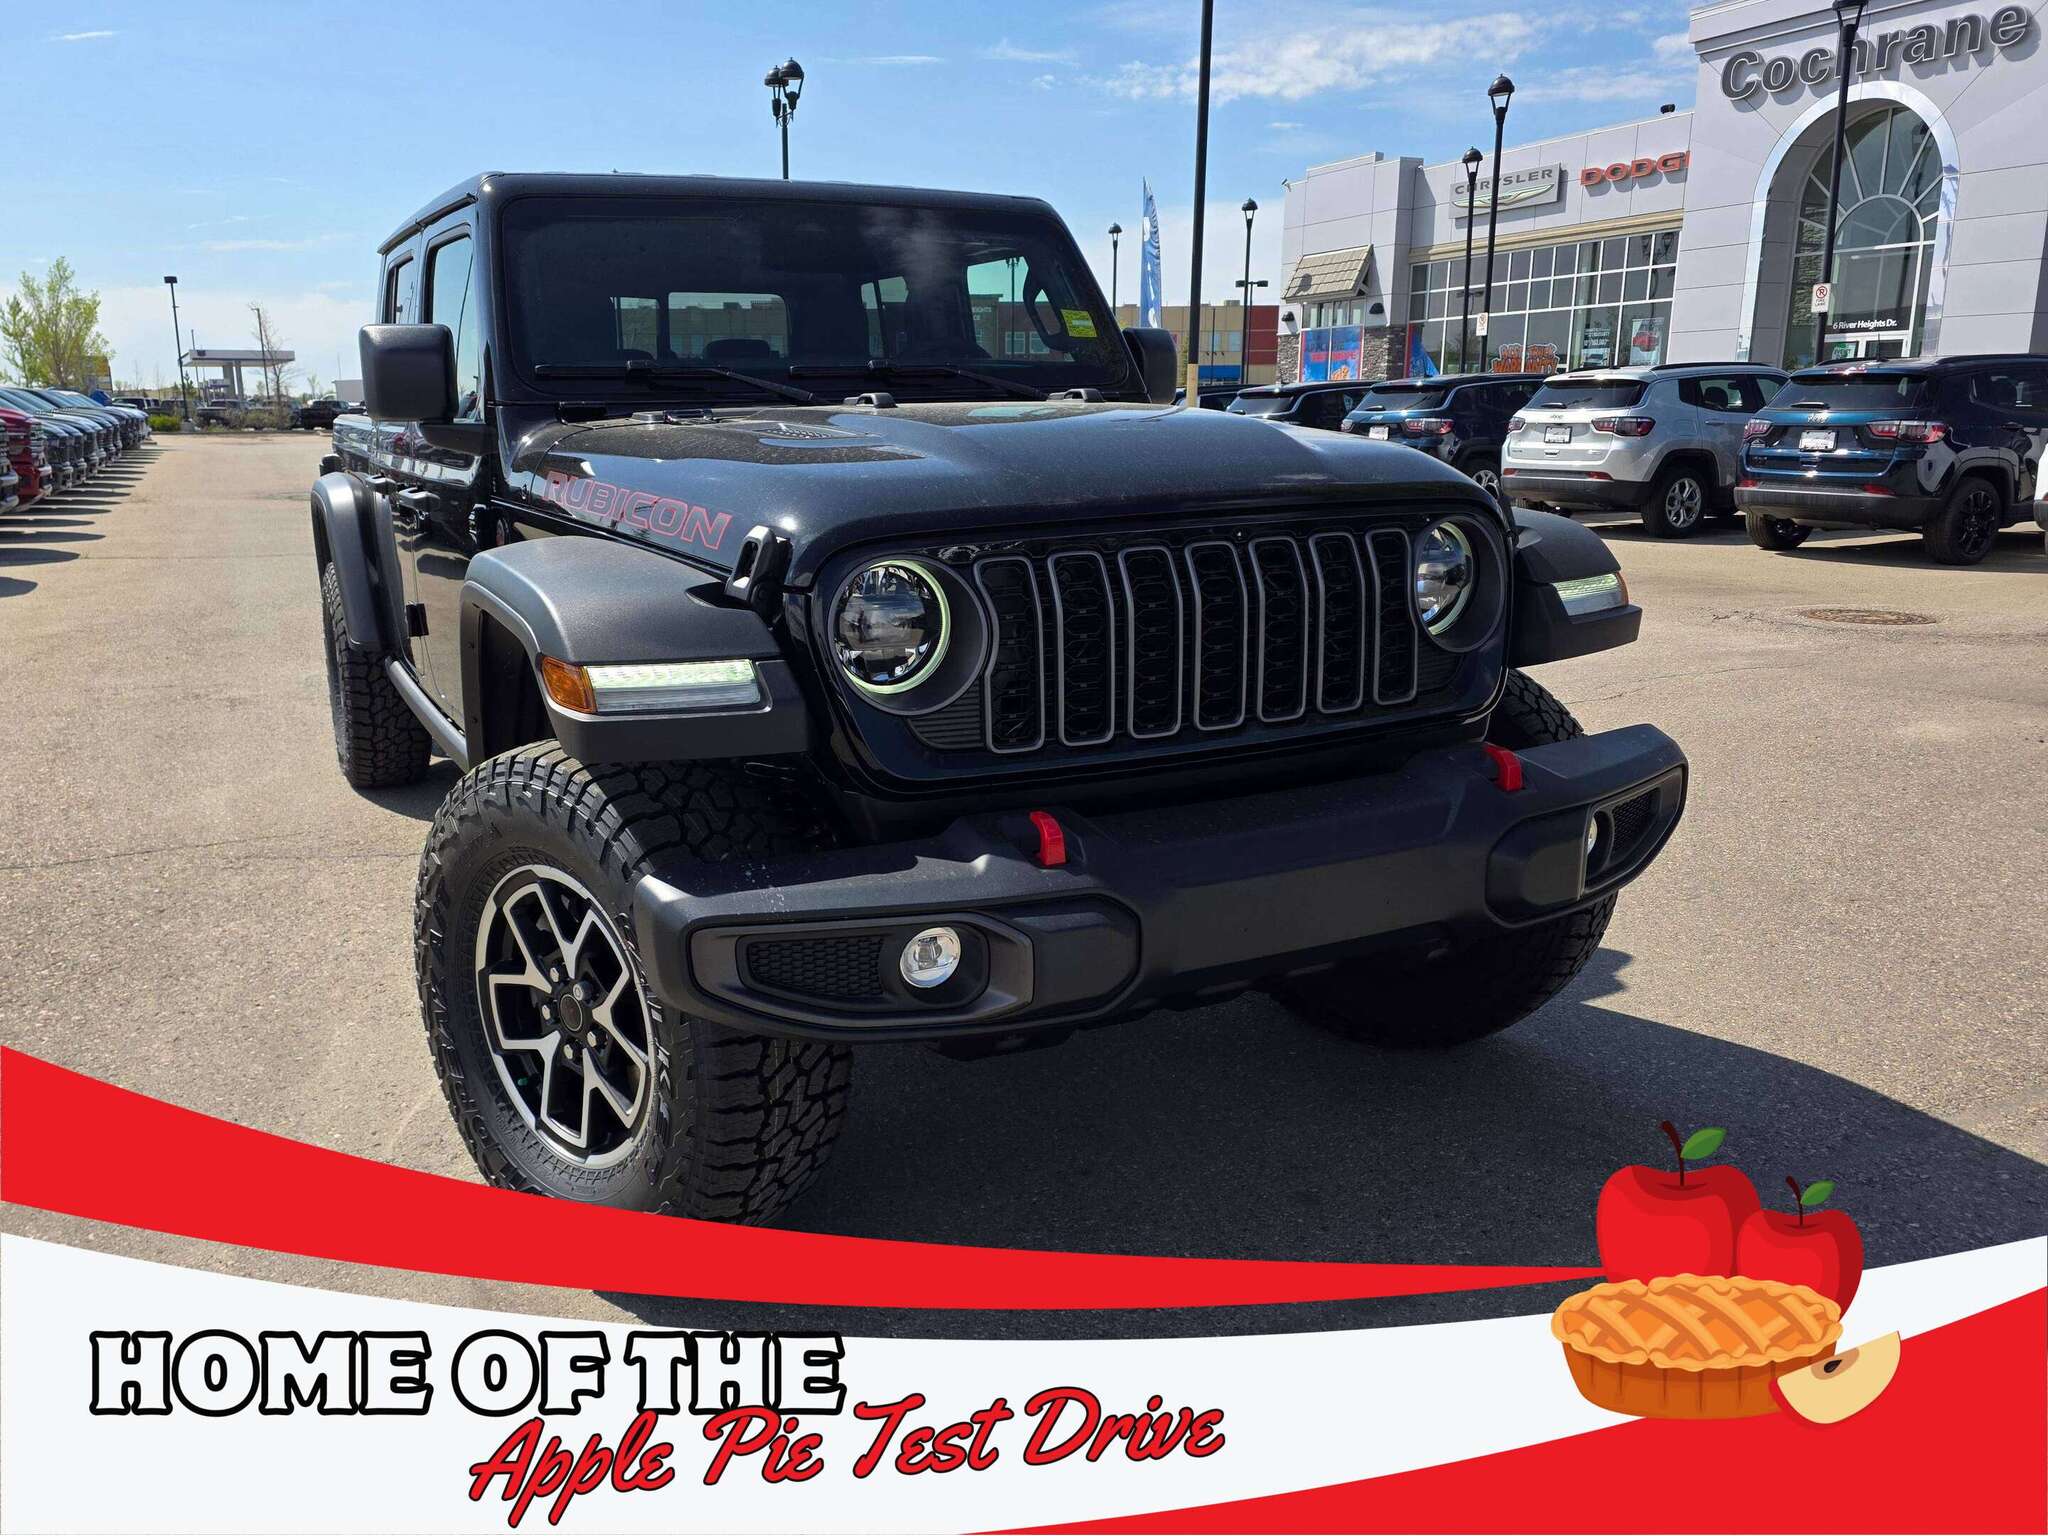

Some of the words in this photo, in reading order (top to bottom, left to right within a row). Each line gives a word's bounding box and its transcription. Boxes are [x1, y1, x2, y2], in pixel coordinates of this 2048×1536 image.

[1720, 5, 2030, 100] Cochrane
[1455, 168, 1553, 195] CHRSLER
[1833, 322, 1838, 330] 6
[1838, 320, 1857, 329] River
[1857, 319, 1885, 330] Heights
[1886, 318, 1897, 327] Dr.
[543, 470, 734, 550] RUBICON
